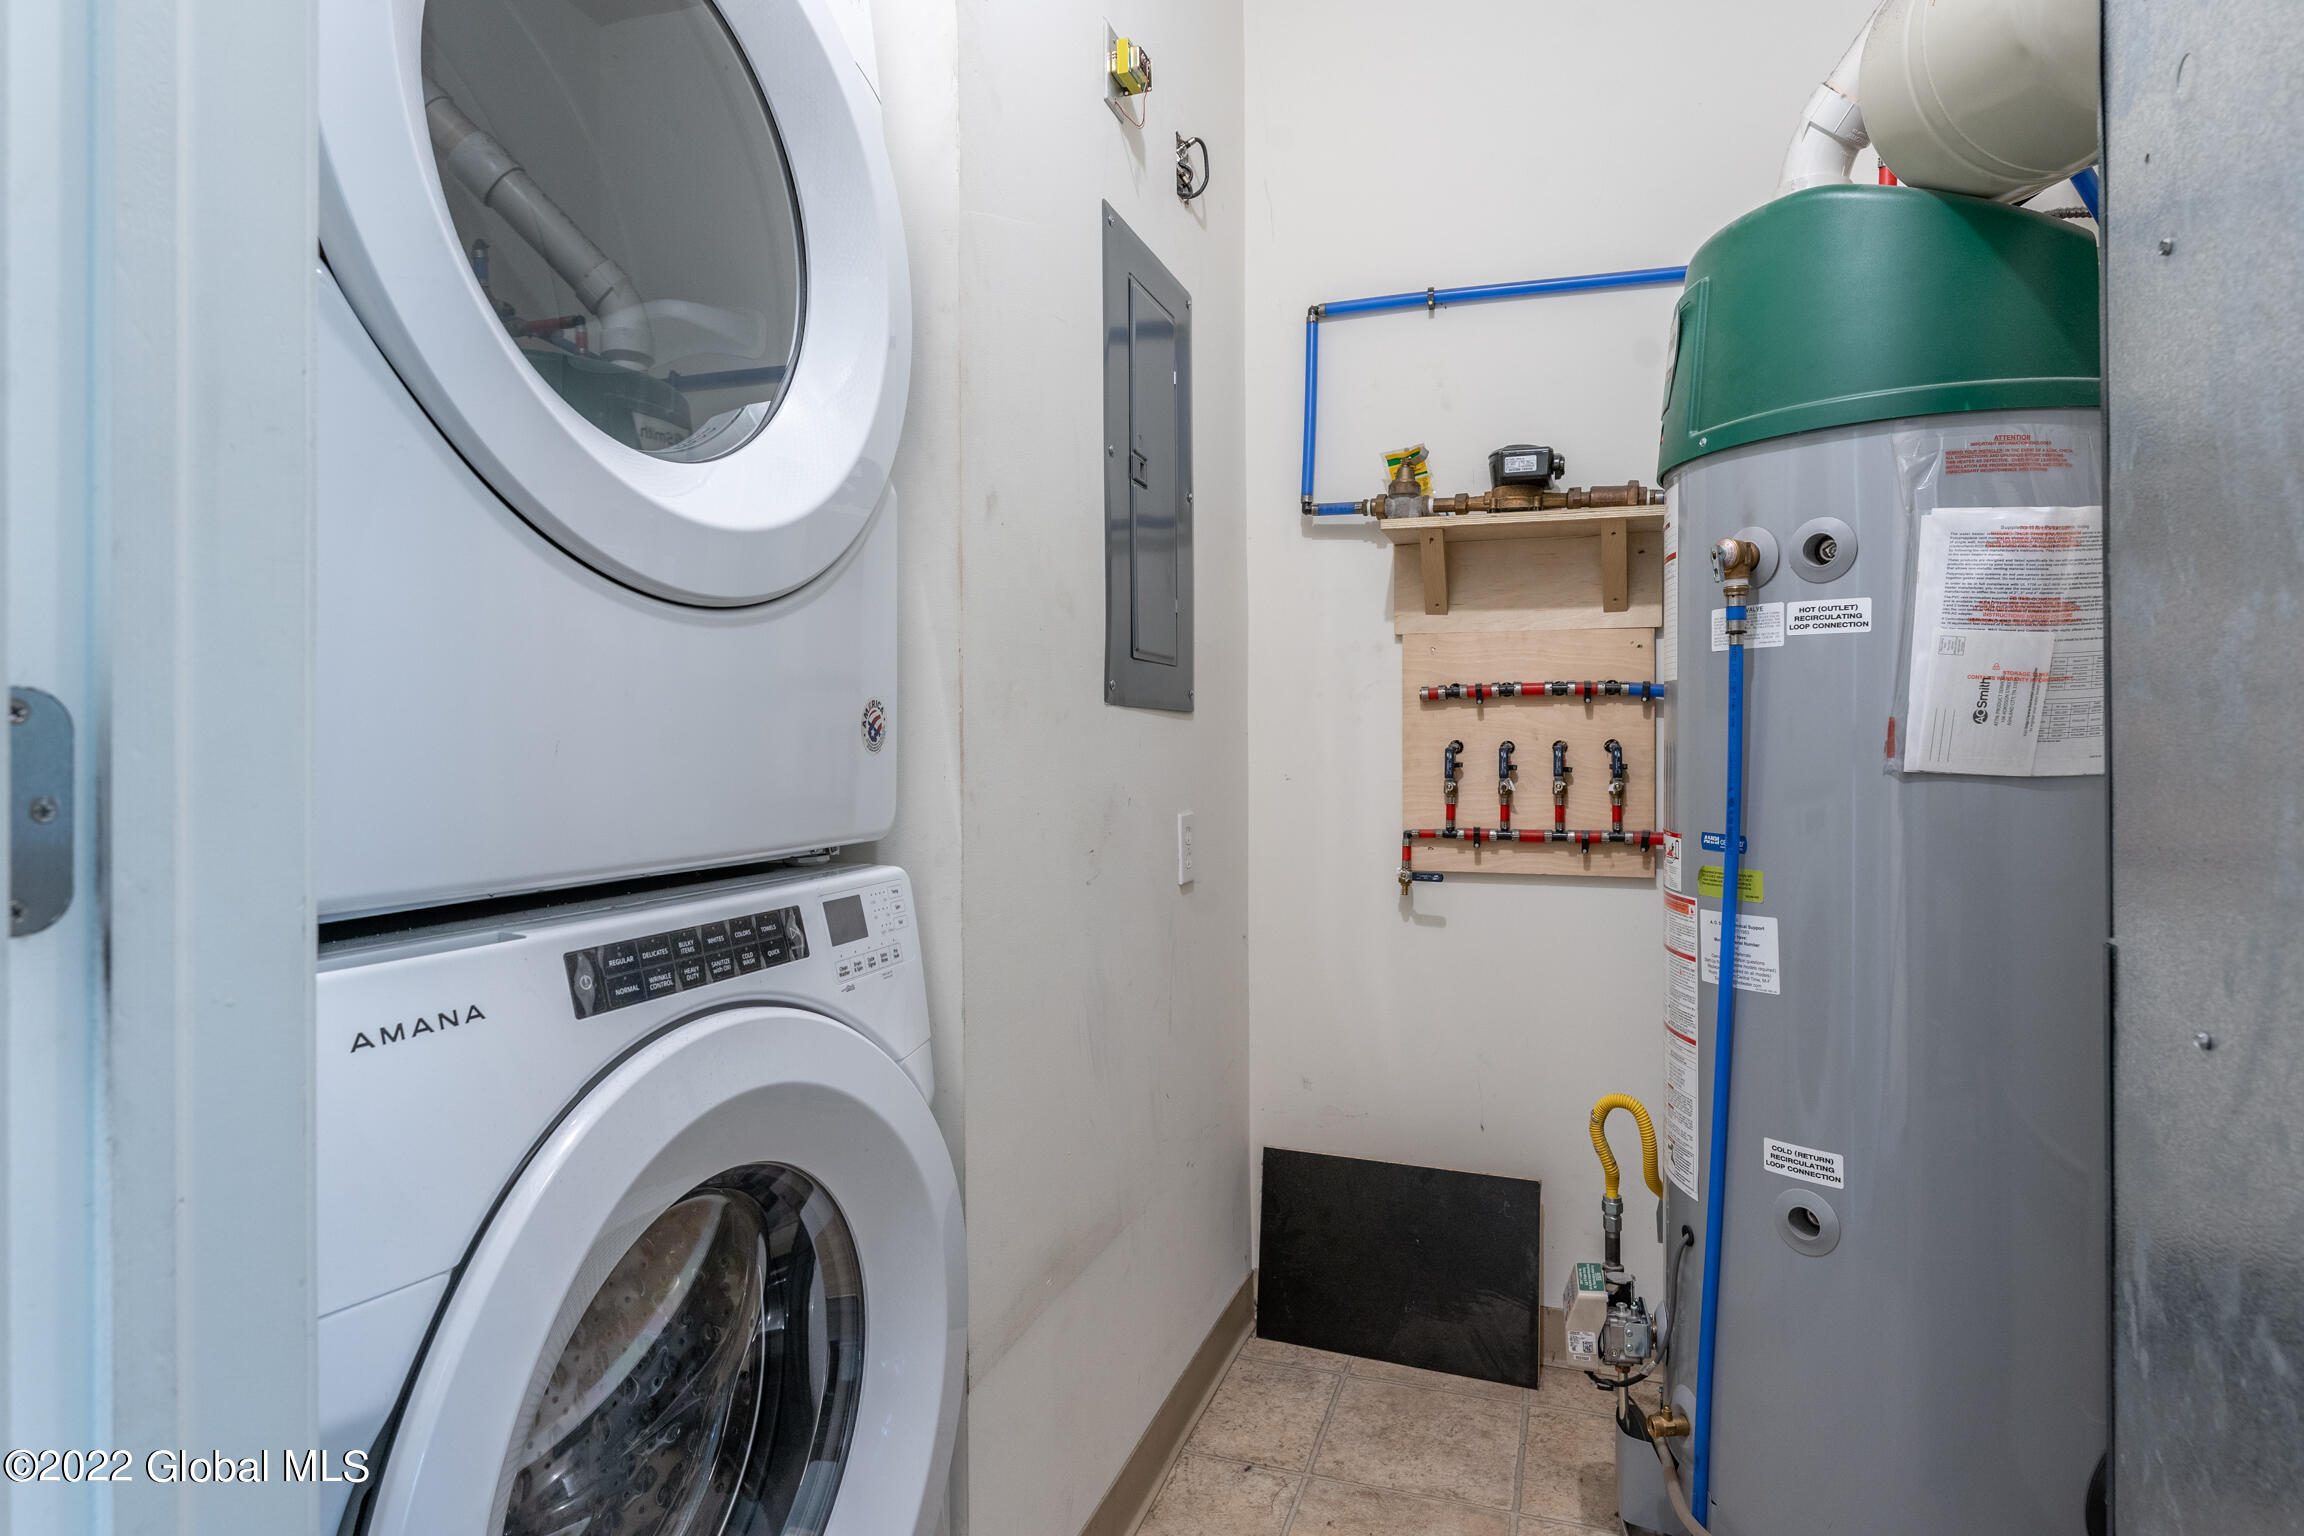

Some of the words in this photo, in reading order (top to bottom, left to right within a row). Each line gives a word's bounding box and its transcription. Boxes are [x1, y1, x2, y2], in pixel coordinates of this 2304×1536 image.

[1818, 604, 1859, 613] (OUTLET)
[1794, 612, 1863, 622] RECIRCULATING
[1789, 622, 1810, 630] LOOP
[1812, 620, 1870, 630] CONNECTION
[1976, 677, 1991, 708] Smith
[760, 924, 776, 932] TOWELS
[734, 929, 752, 938] COLORS
[678, 940, 694, 948] BULKY
[707, 935, 724, 944] WHITES
[642, 948, 668, 959] DELICATES
[767, 949, 780, 957] QUICK
[608, 956, 634, 967] REGULAR
[711, 958, 730, 968] SANITIZE
[684, 966, 699, 975] HEAVY
[649, 972, 671, 983] WRINKLE
[686, 973, 699, 981] DUTY
[650, 980, 674, 990] CONTROL
[616, 985, 640, 996] NORMAL
[350, 1004, 486, 1054] AMANA
[1771, 1144, 1792, 1155] COLD
[1794, 1150, 1834, 1166] (RETURN)
[1770, 1152, 1835, 1174] RECIRCULATING
[1766, 1160, 1786, 1170] LOOP
[1787, 1164, 1842, 1184] CONNECTION
